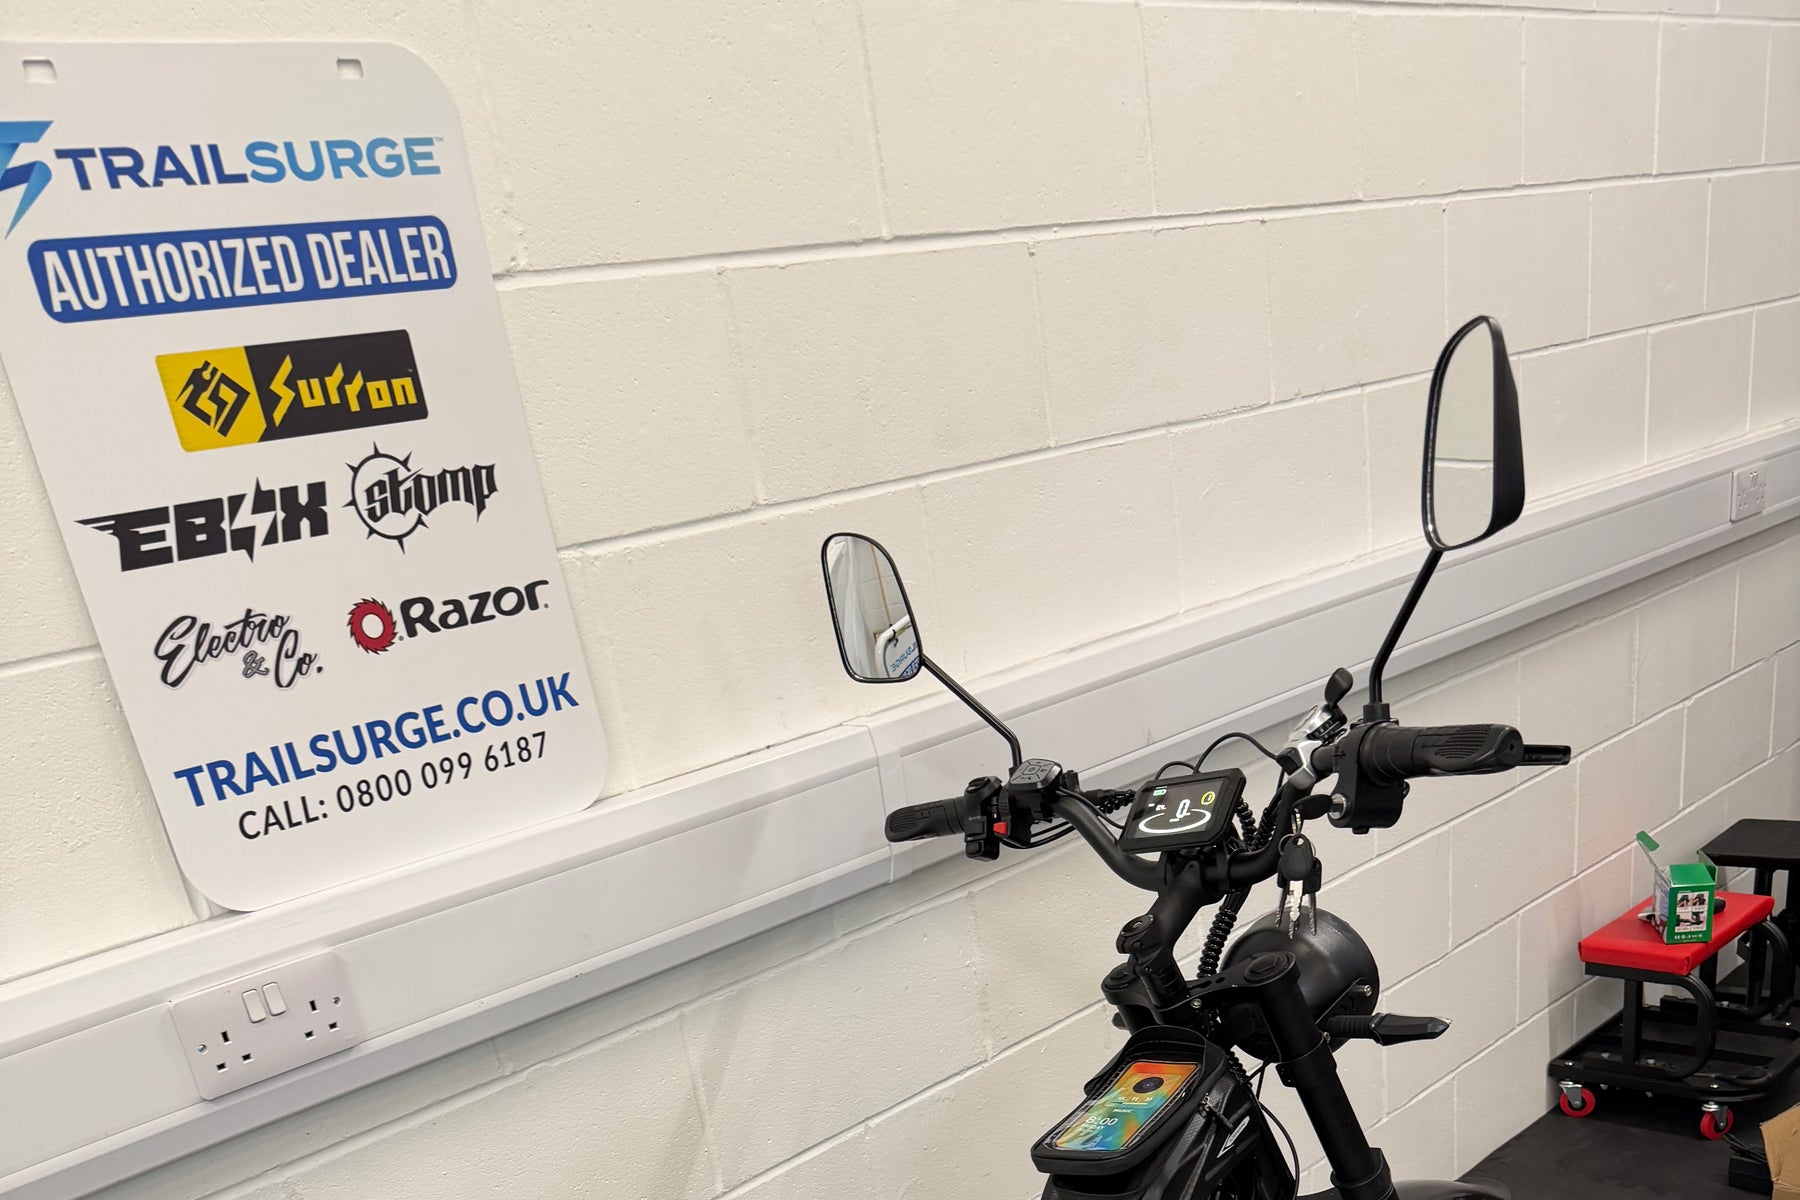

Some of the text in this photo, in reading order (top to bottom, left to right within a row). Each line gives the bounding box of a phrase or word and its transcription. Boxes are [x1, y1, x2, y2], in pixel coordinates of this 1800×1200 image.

[54, 136, 442, 191] TRAILSURGE
[43, 225, 452, 313] AUTHORIZED DEALER
[269, 354, 418, 428] Surron
[400, 580, 549, 638] Razor
[154, 608, 290, 687] Electro
[242, 629, 323, 688] & Co.
[173, 672, 580, 808] TRAILSURGE.CO.UK
[238, 731, 547, 840] CALL: 0800 099 6187
